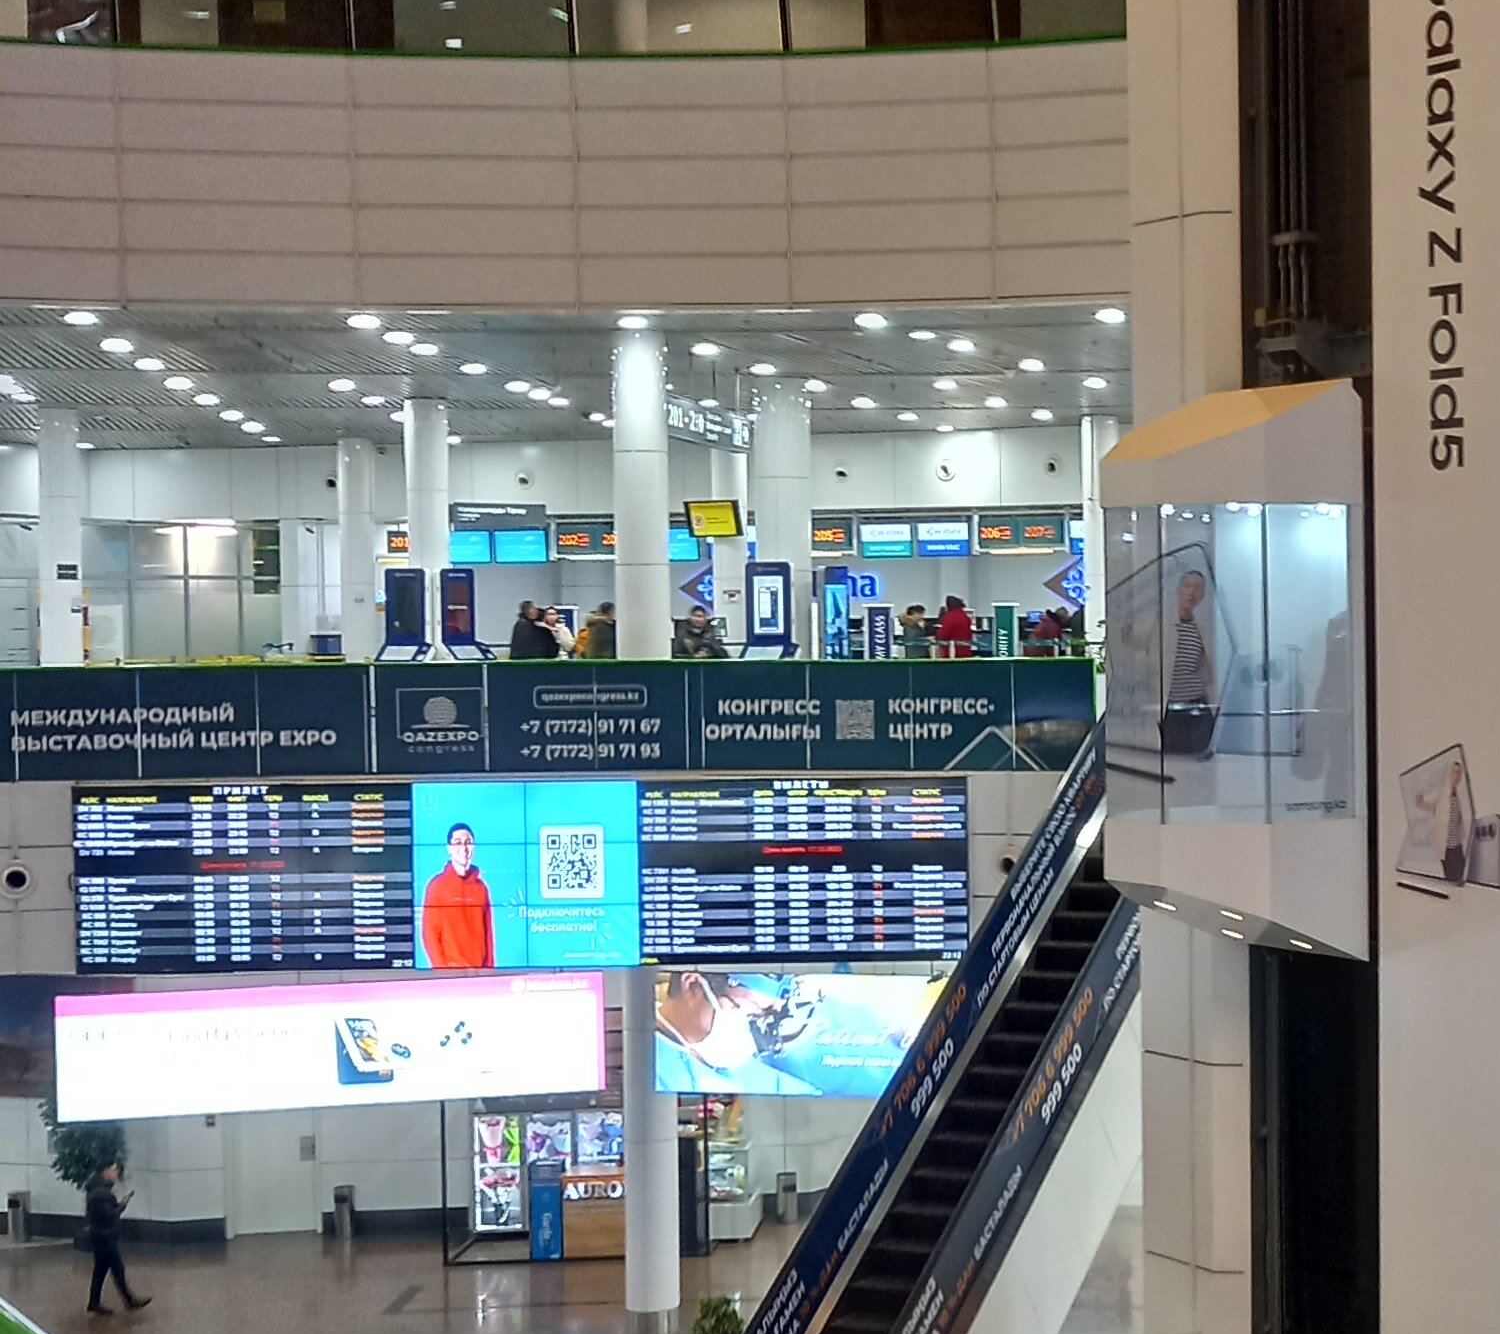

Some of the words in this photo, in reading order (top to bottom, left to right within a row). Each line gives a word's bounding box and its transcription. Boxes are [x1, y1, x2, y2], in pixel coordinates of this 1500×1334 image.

[1427, 227, 1462, 268] Z
[1427, 282, 1466, 472] Fold5
[601, 534, 618, 547] 20
[10, 702, 235, 727] МЕЖДУНАРОДНЫЙ
[717, 698, 822, 716] КОНГРЕСС
[402, 730, 480, 743] QAZEXPO
[519, 720, 541, 734] +7
[544, 718, 593, 736] (7172)
[597, 719, 615, 734] 91
[617, 719, 636, 734] 71
[639, 718, 662, 734] 67
[888, 722, 954, 742] ЦЕНТР
[11, 728, 196, 753] ВЫСТАВОЧНЫЙ
[201, 730, 274, 752] ЦЕНТР
[279, 729, 338, 748] EXPO
[519, 745, 541, 759] +7
[544, 743, 594, 761] (7172)
[597, 744, 615, 759] 91
[617, 744, 636, 759] 71
[911, 1078, 934, 1118] 999
[932, 1037, 955, 1082] 500
[1041, 1079, 1063, 1126] 999
[1061, 1042, 1083, 1087] 500
[563, 1180, 626, 1201] AURO
